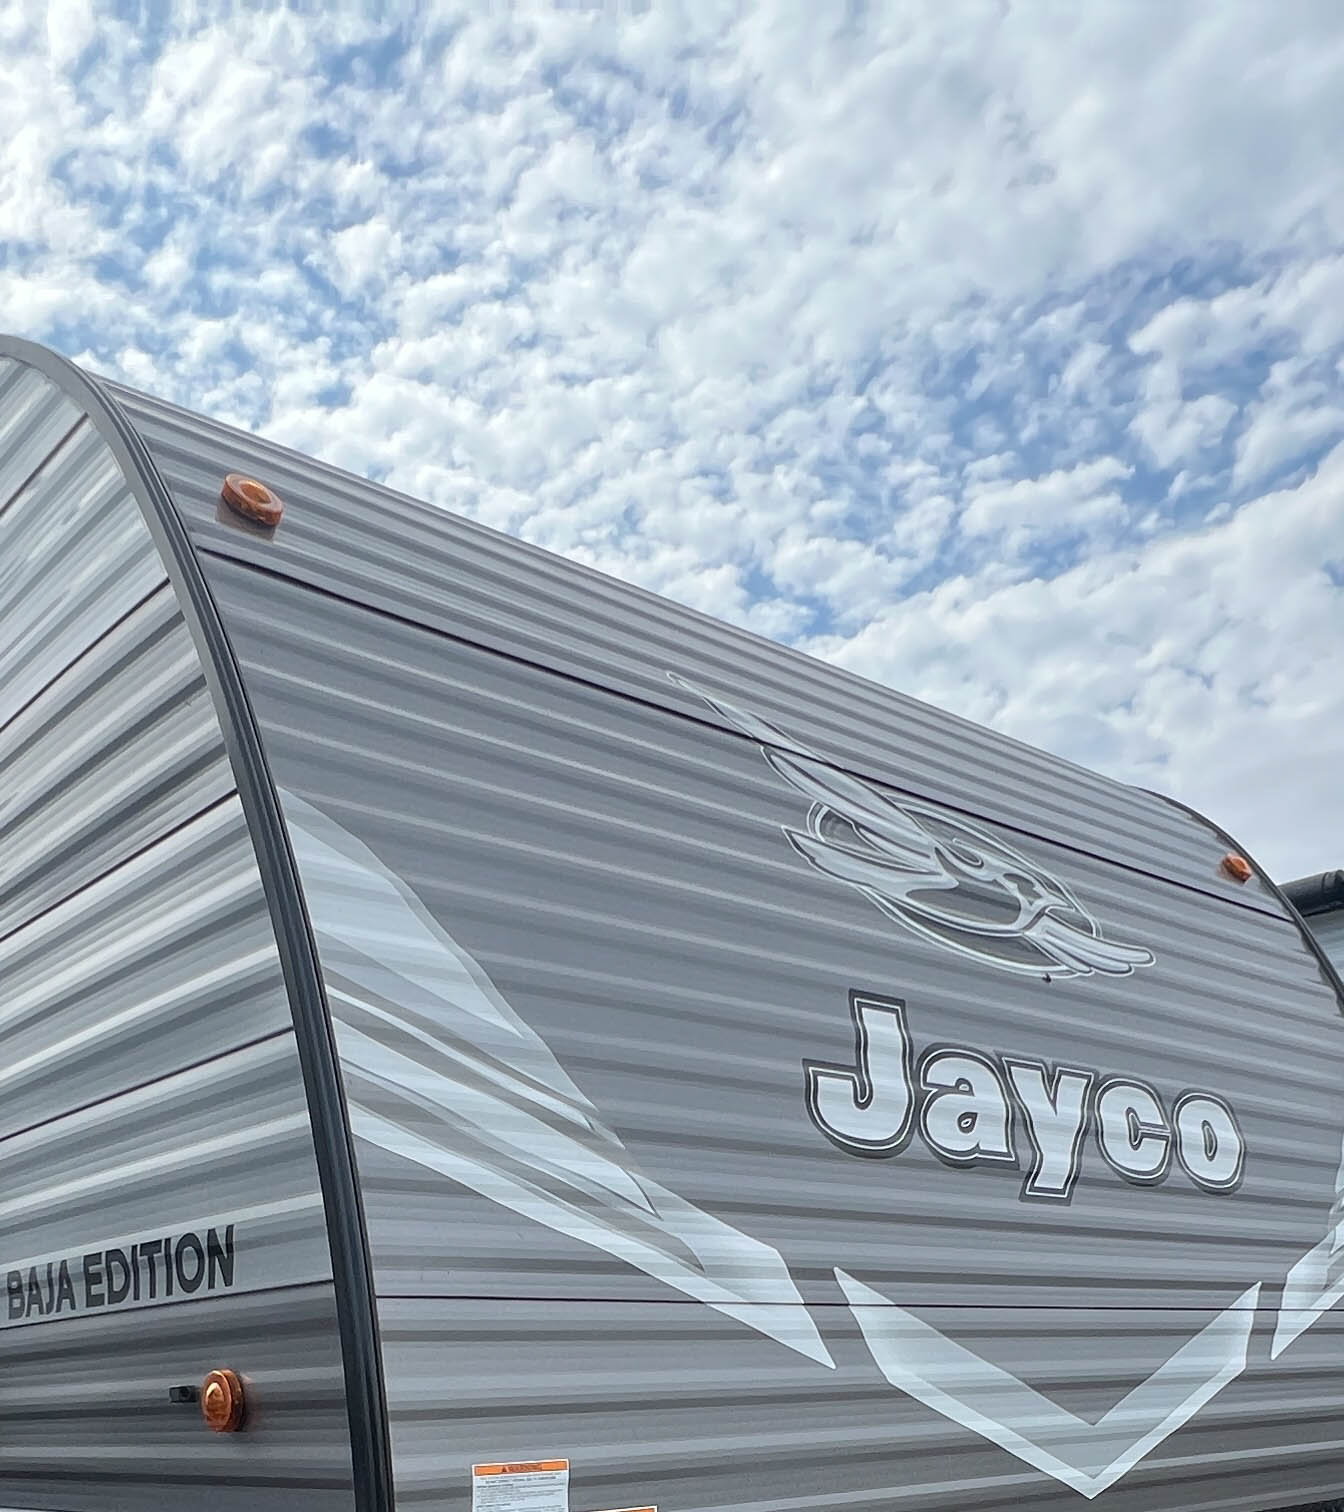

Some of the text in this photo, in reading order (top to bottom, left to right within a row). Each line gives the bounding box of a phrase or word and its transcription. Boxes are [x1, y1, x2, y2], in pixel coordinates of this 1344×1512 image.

[802, 990, 1246, 1205] Jayco
[7, 1224, 235, 1320] BAJA EDITION
